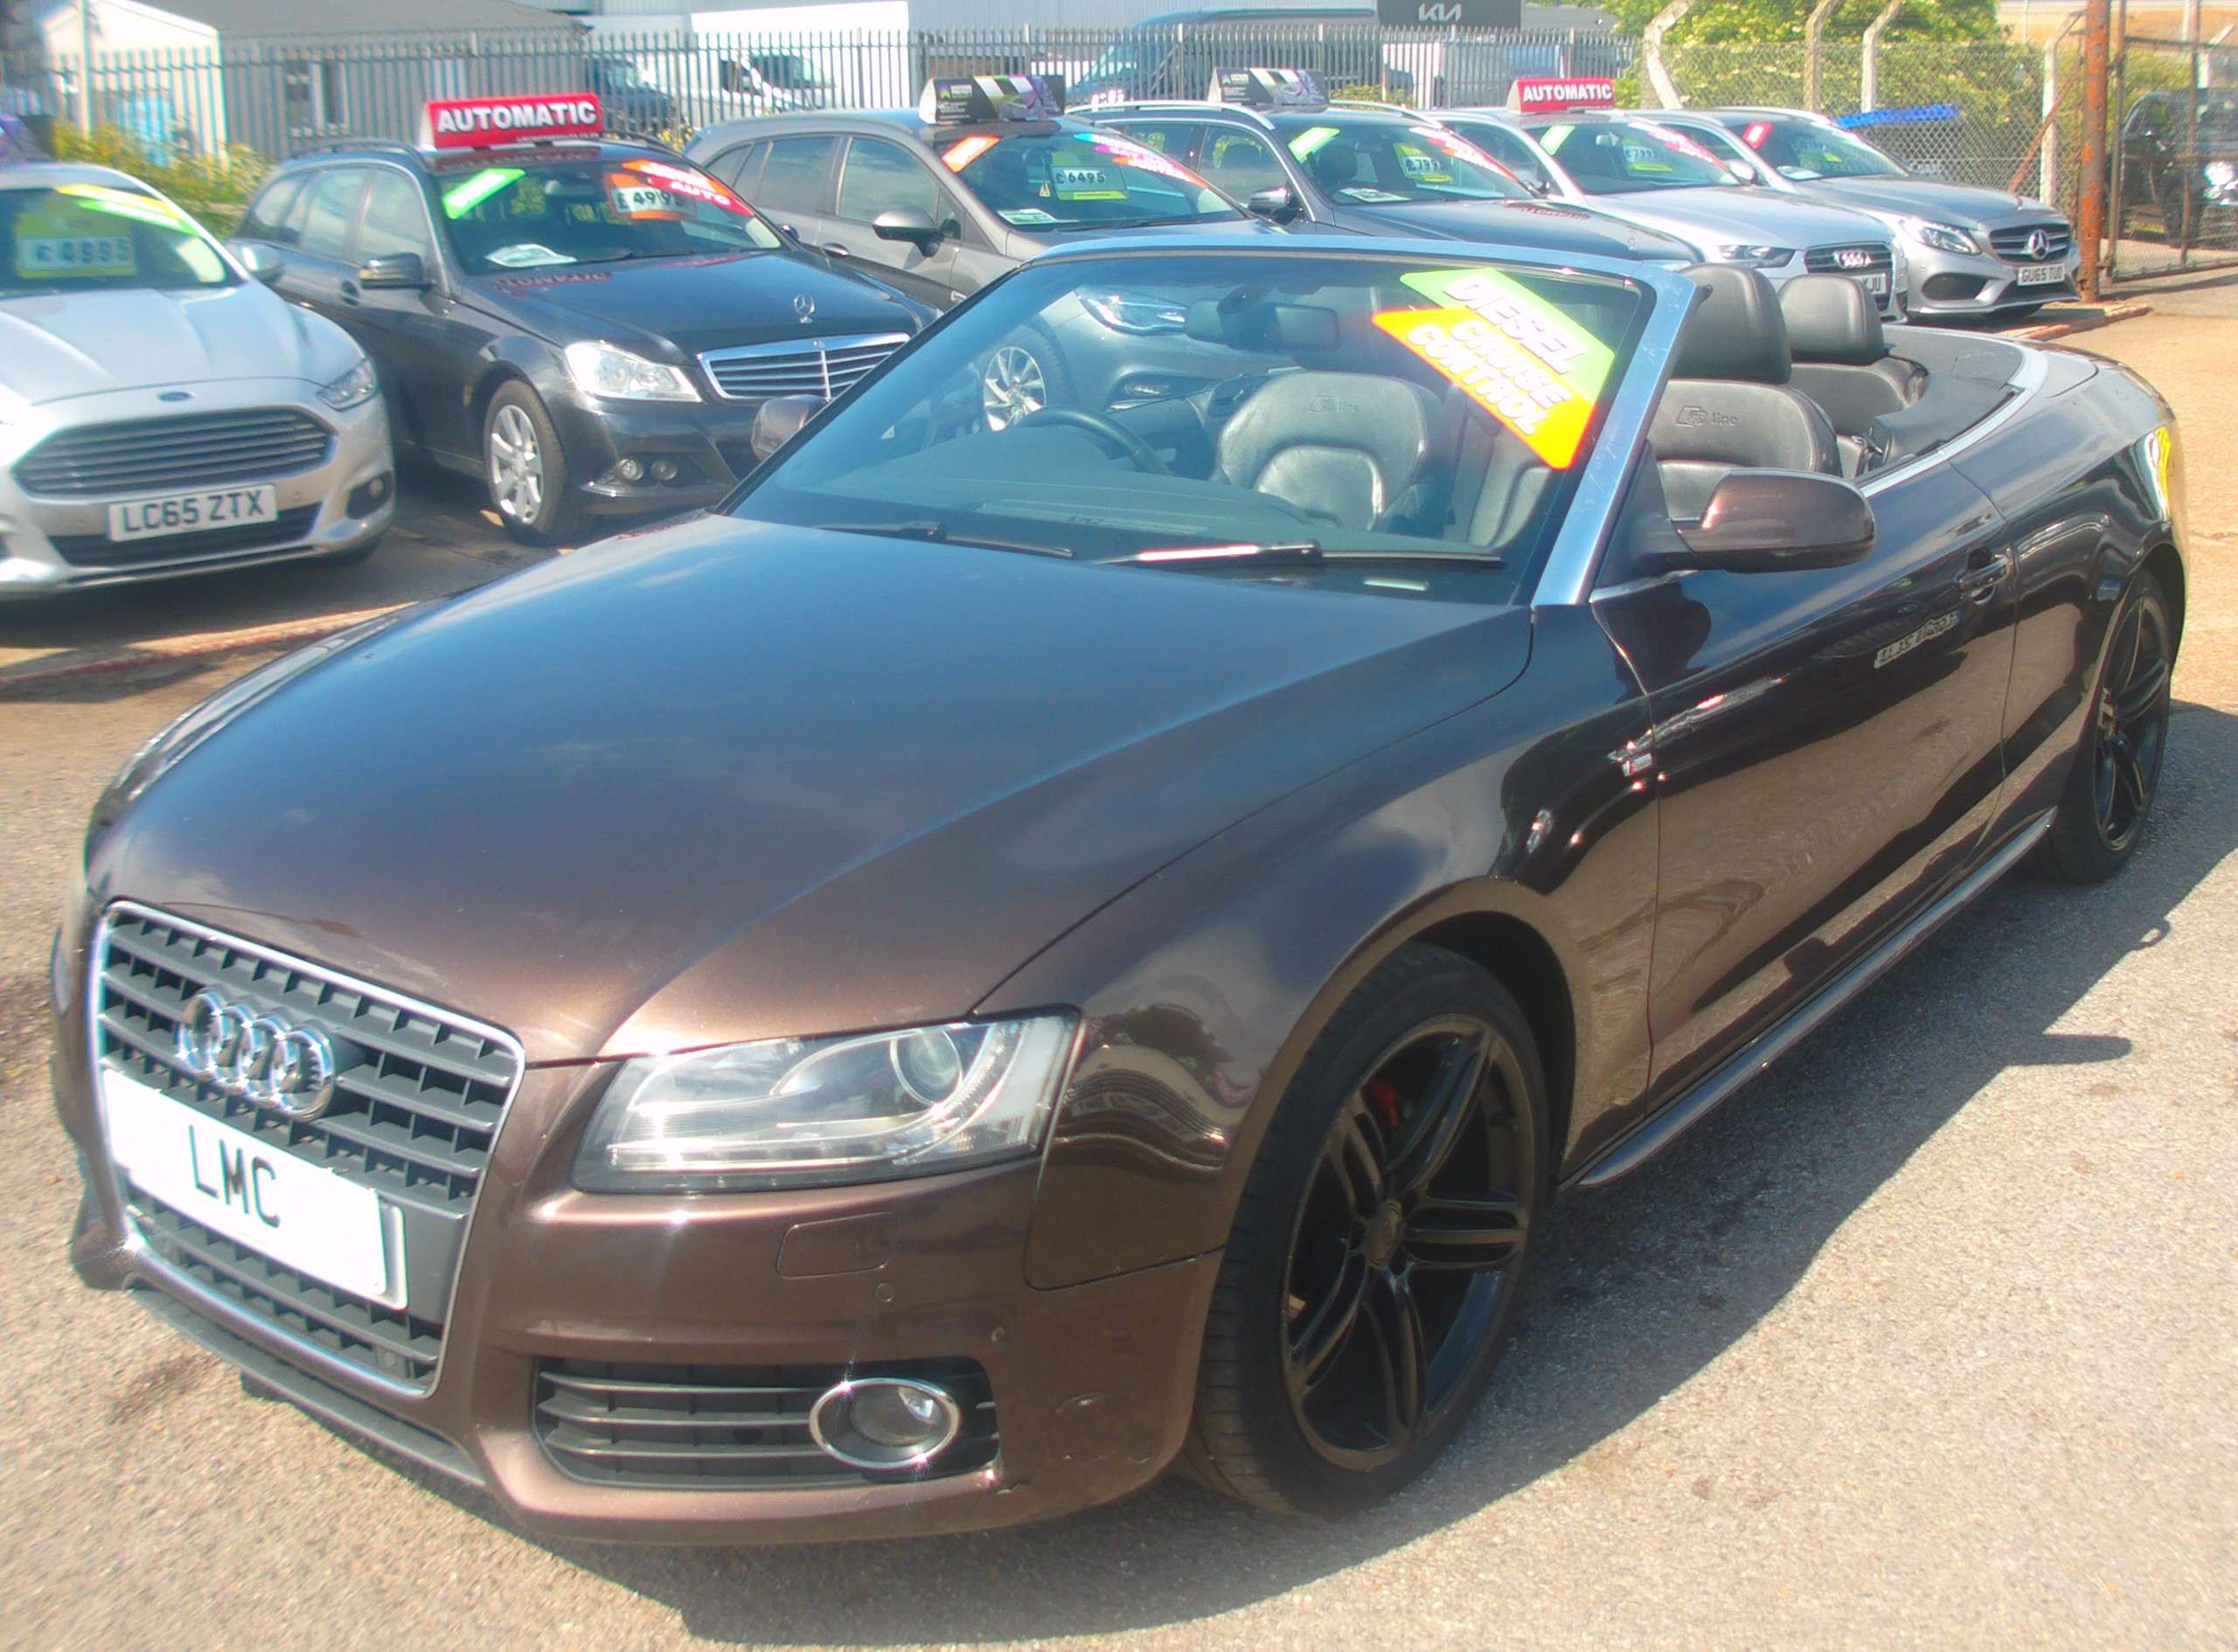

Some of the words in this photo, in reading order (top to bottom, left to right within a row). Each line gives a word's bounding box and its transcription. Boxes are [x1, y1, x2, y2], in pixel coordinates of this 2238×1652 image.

[1419, 3, 1462, 22] KIA
[1523, 84, 1613, 102] AUTOMATIC
[437, 101, 598, 133] AUTOMATIC
[670, 181, 731, 205] AUTO
[1442, 274, 1587, 375] DIESEL
[1407, 324, 1548, 436] CONTROL
[1450, 320, 1574, 410] CRUISE
[122, 497, 201, 532] LC65
[206, 489, 264, 521] ZTX
[188, 1123, 281, 1229] LMC
